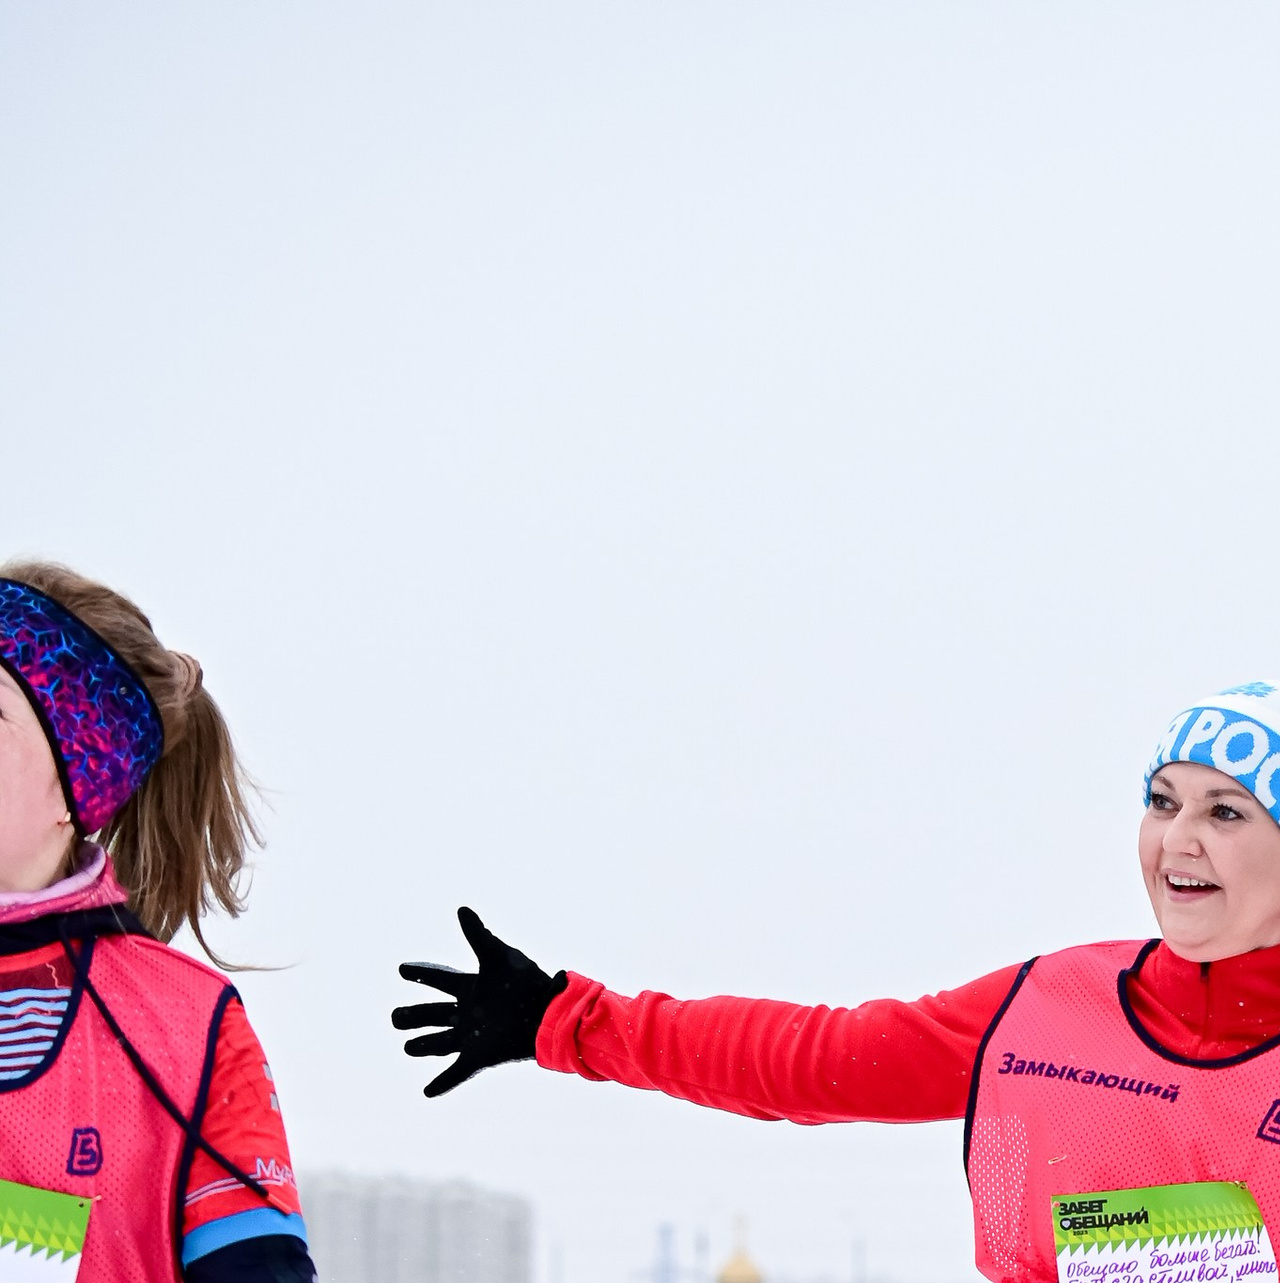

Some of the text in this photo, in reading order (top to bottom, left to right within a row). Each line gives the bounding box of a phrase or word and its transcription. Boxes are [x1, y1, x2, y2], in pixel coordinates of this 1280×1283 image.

[998, 1052, 1181, 1103] Замыкающий
[1058, 1199, 1108, 1216] ЗАБЕГ
[1060, 1206, 1149, 1232] ОБЕЩАНИЙ
